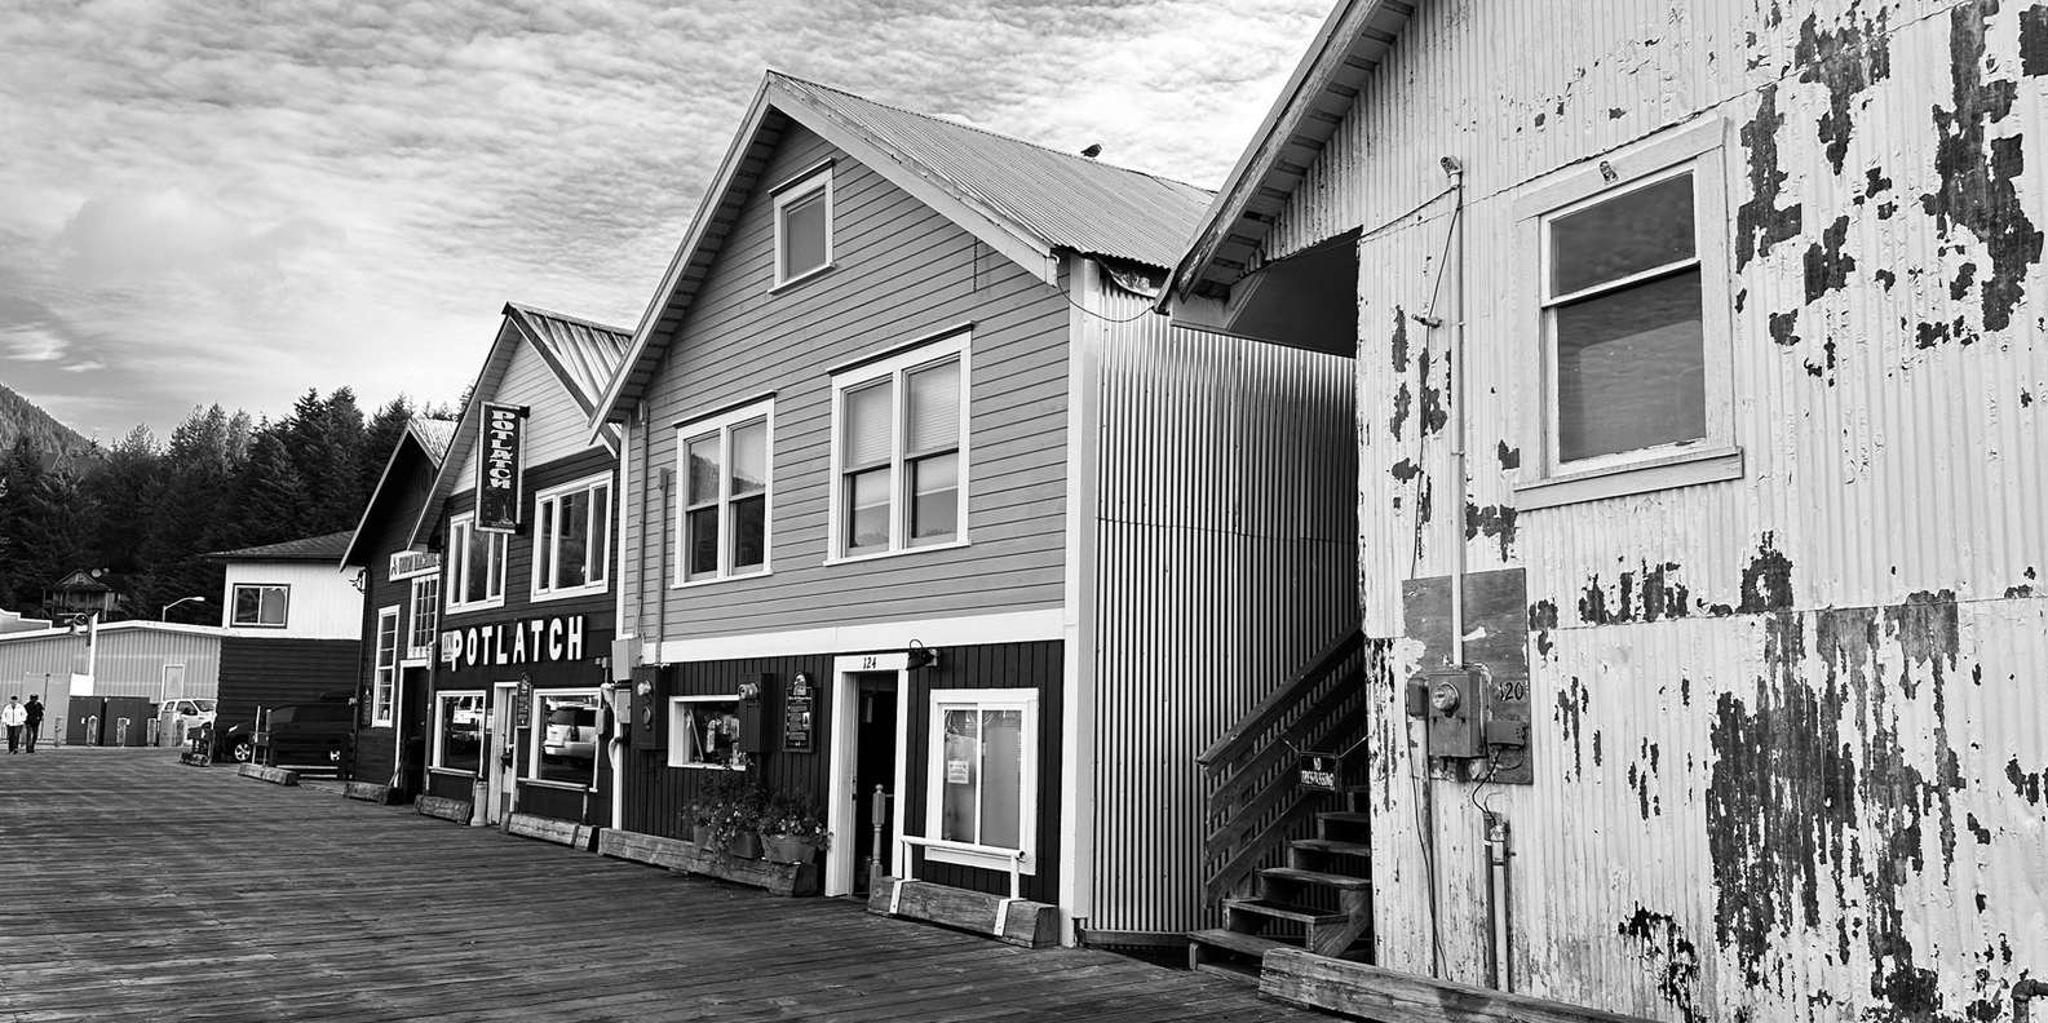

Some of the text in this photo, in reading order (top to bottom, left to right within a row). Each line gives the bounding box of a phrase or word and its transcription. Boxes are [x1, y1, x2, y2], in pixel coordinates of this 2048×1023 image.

[488, 410, 516, 489] POTLATCH
[452, 615, 583, 672] POTLATCH
[863, 657, 877, 670] 124
